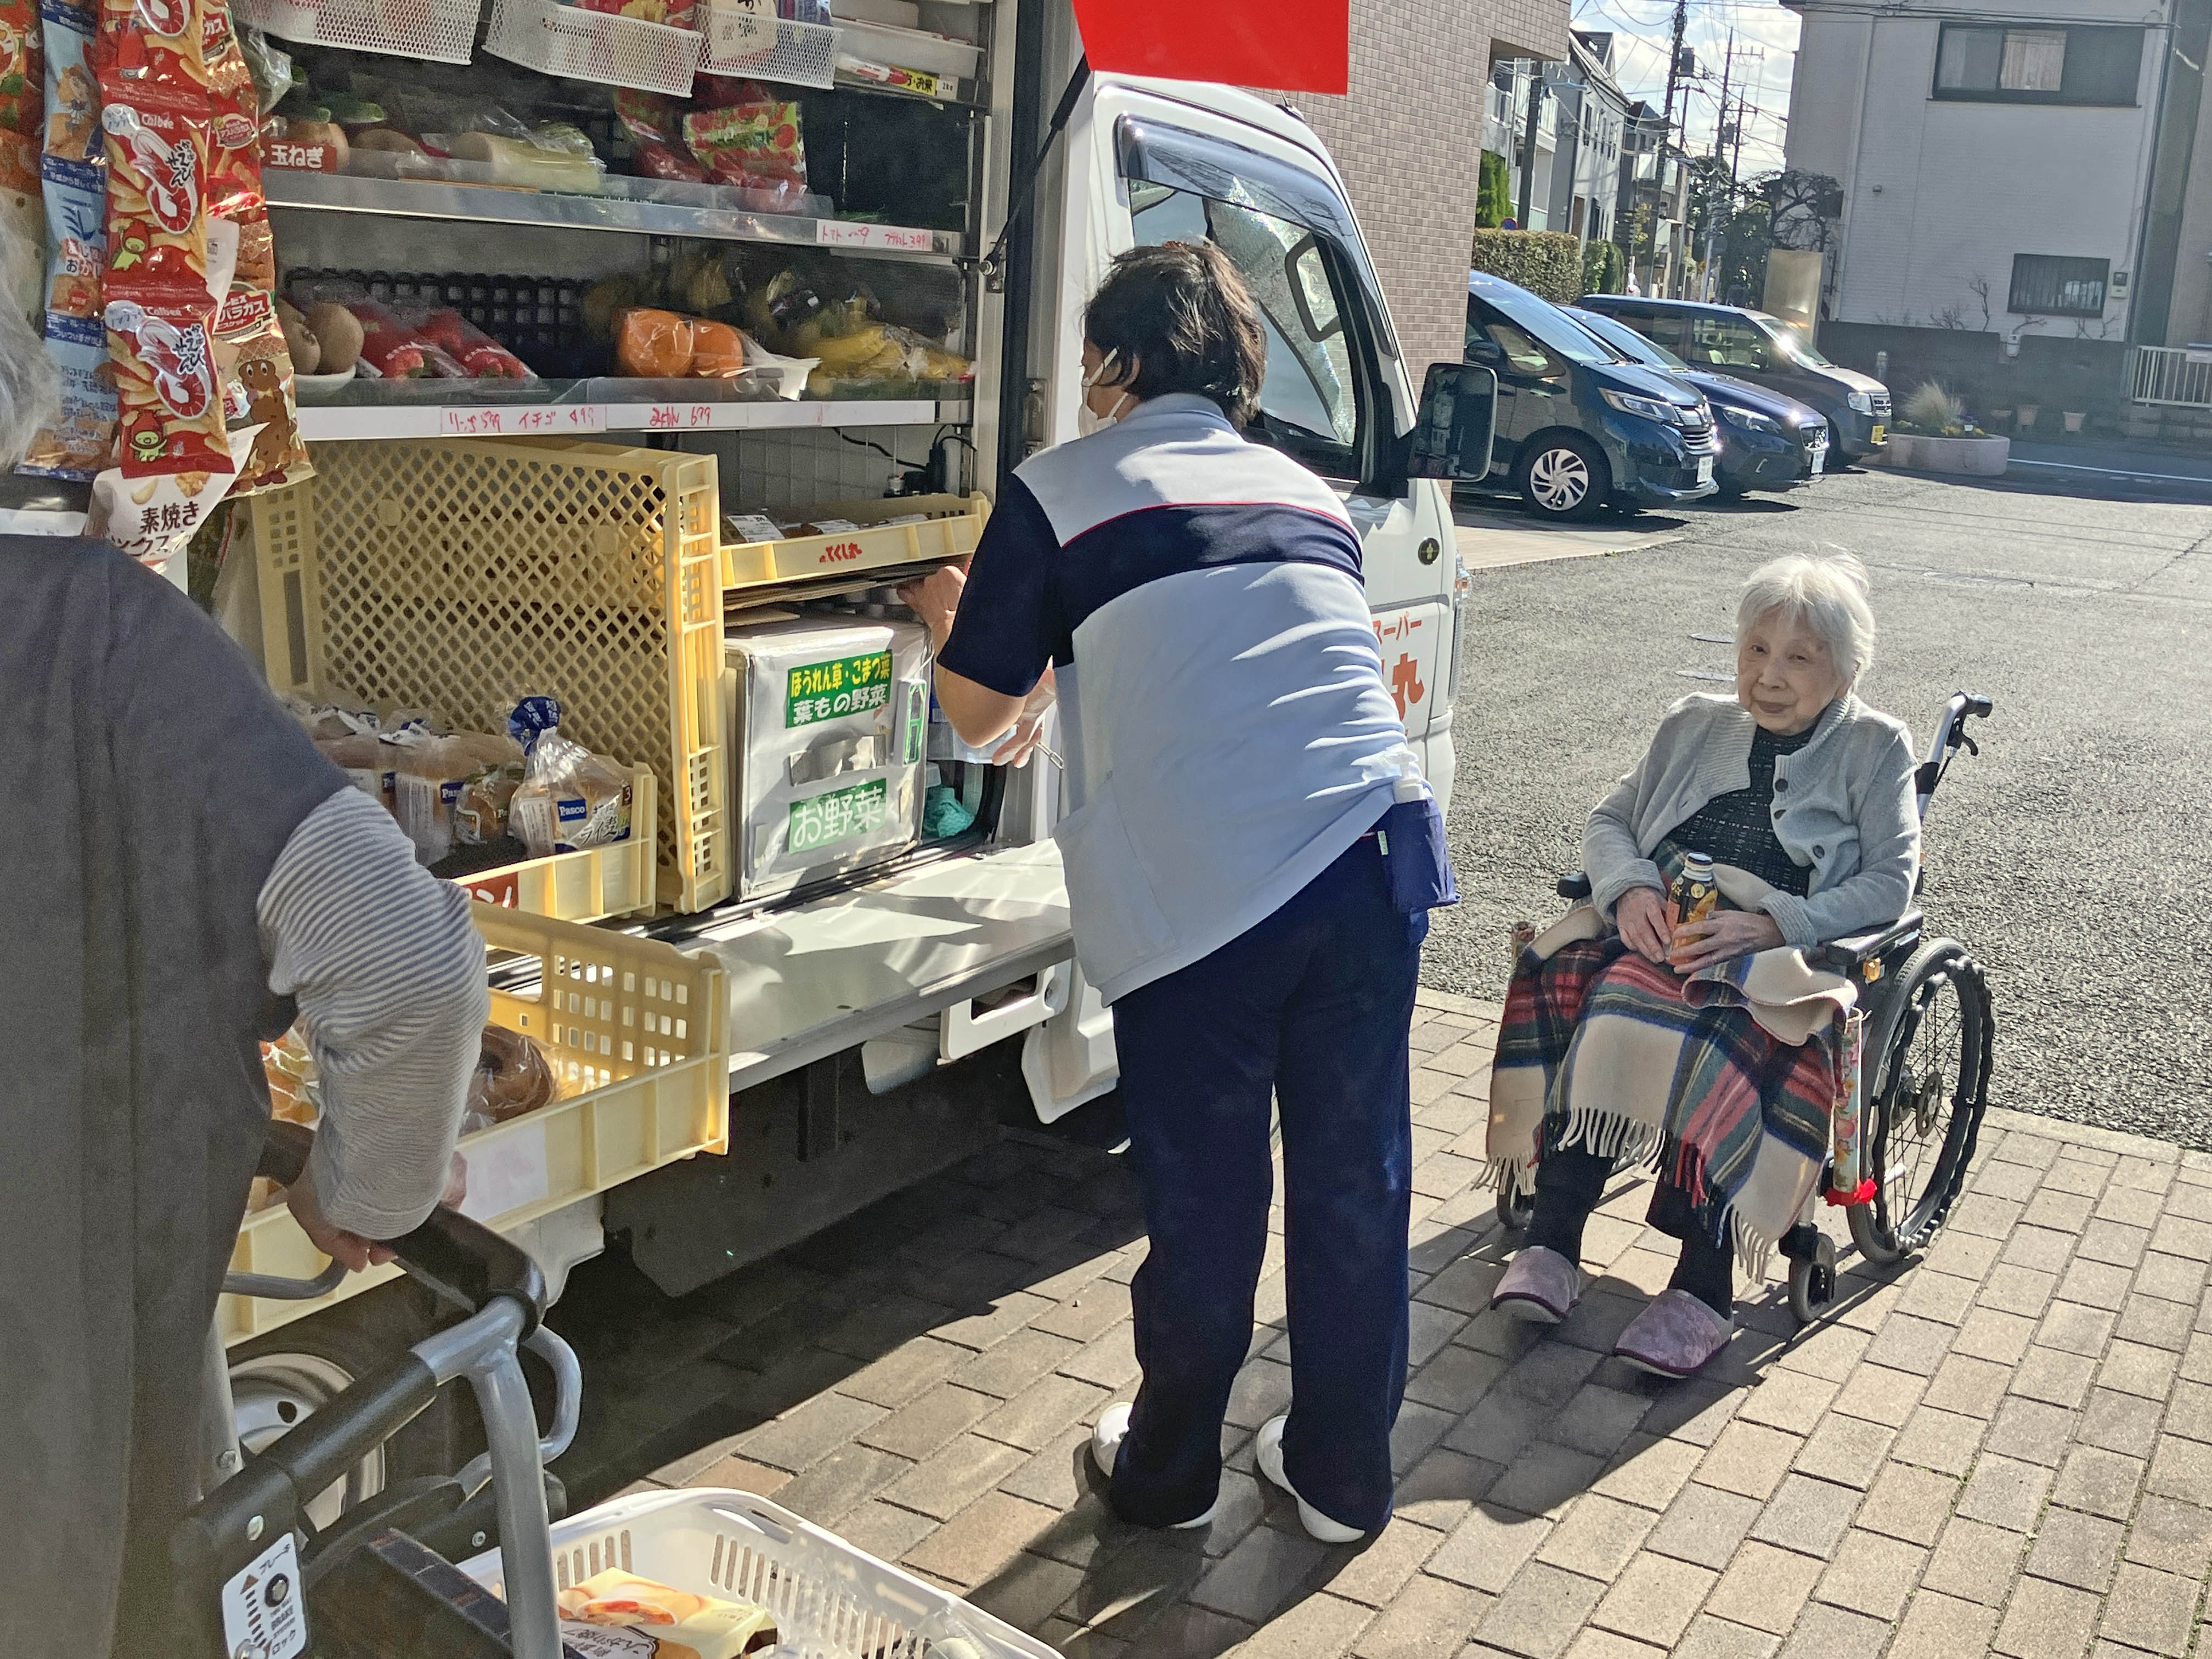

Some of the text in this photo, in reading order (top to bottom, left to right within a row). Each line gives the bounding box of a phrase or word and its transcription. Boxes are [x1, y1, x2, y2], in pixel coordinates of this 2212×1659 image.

[146, 306, 182, 317] Calbee
[518, 411, 556, 429] イチゴ
[139, 500, 199, 535] 素焼き
[791, 653, 891, 698] ほうれん草・こまつ菜
[1381, 652, 1425, 721] 丸
[793, 683, 888, 725] 葉もの野菜
[559, 804, 585, 816] Pasco
[793, 785, 883, 848] お野菜
[581, 815, 618, 845] ライ麦
